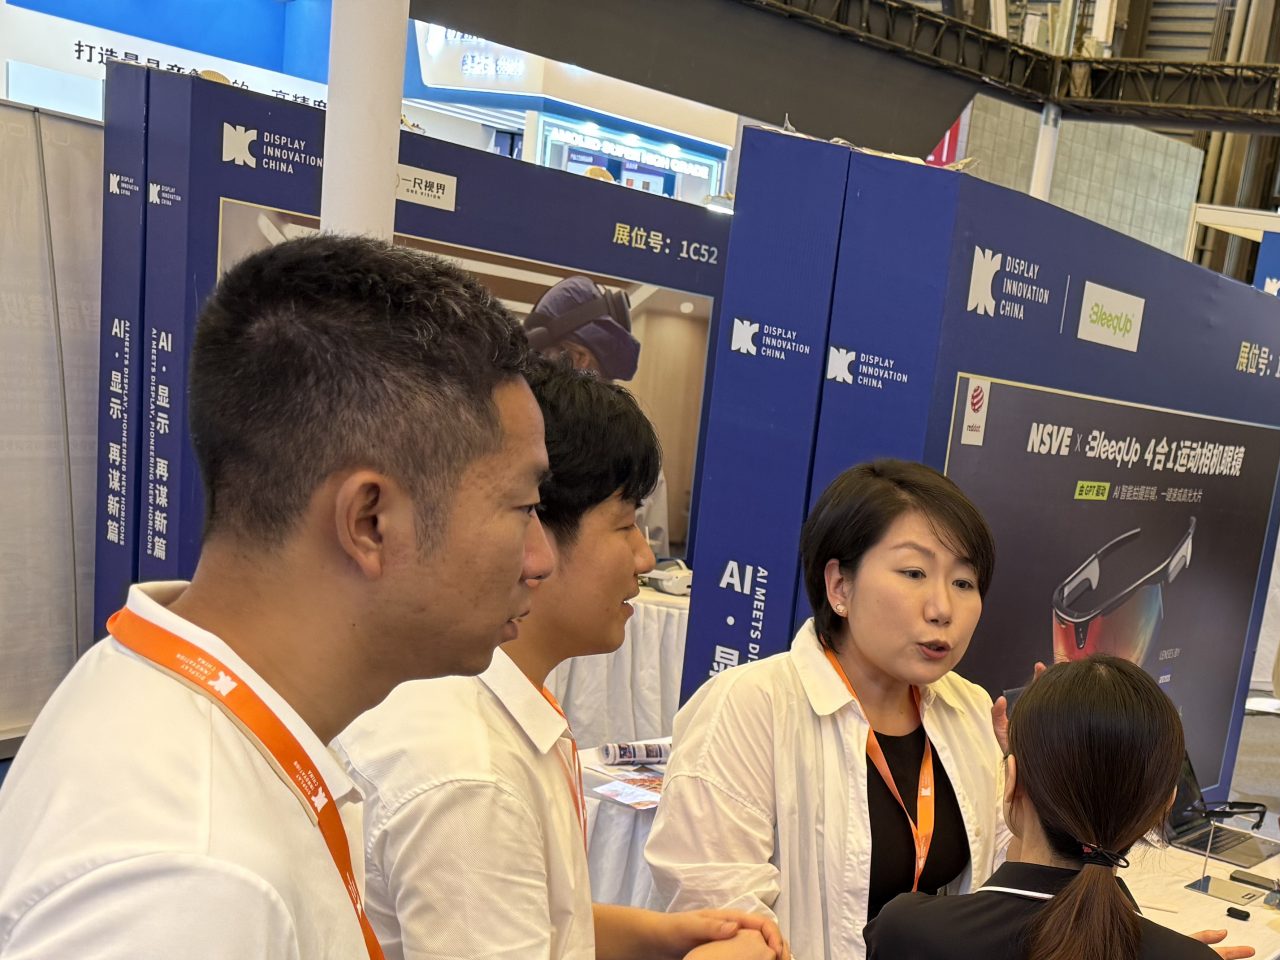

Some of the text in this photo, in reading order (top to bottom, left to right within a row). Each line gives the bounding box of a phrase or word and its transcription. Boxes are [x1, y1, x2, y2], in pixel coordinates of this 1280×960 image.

[263, 132, 306, 150] DISPLAY
[263, 145, 323, 167] INNOVATION
[262, 159, 294, 174] CHINA
[1006, 255, 1040, 280] DISPLAY
[1003, 278, 1049, 305] INNOVATION
[1000, 300, 1024, 321] CHINA
[763, 325, 797, 340] DISPLAY
[761, 347, 786, 360] CHINA
[762, 336, 810, 355] INNOVATION
[860, 353, 894, 368] DISPLAY
[857, 375, 883, 389] CHINA
[859, 364, 908, 383] INNOVATION
[1027, 422, 1073, 456] NSVE
[1144, 437, 1245, 477] 4合1运动相机眼镜
[107, 442, 121, 544] 再谋新篇
[153, 457, 169, 560] 再谋新篇
[747, 566, 768, 663] AI MEETS DI
